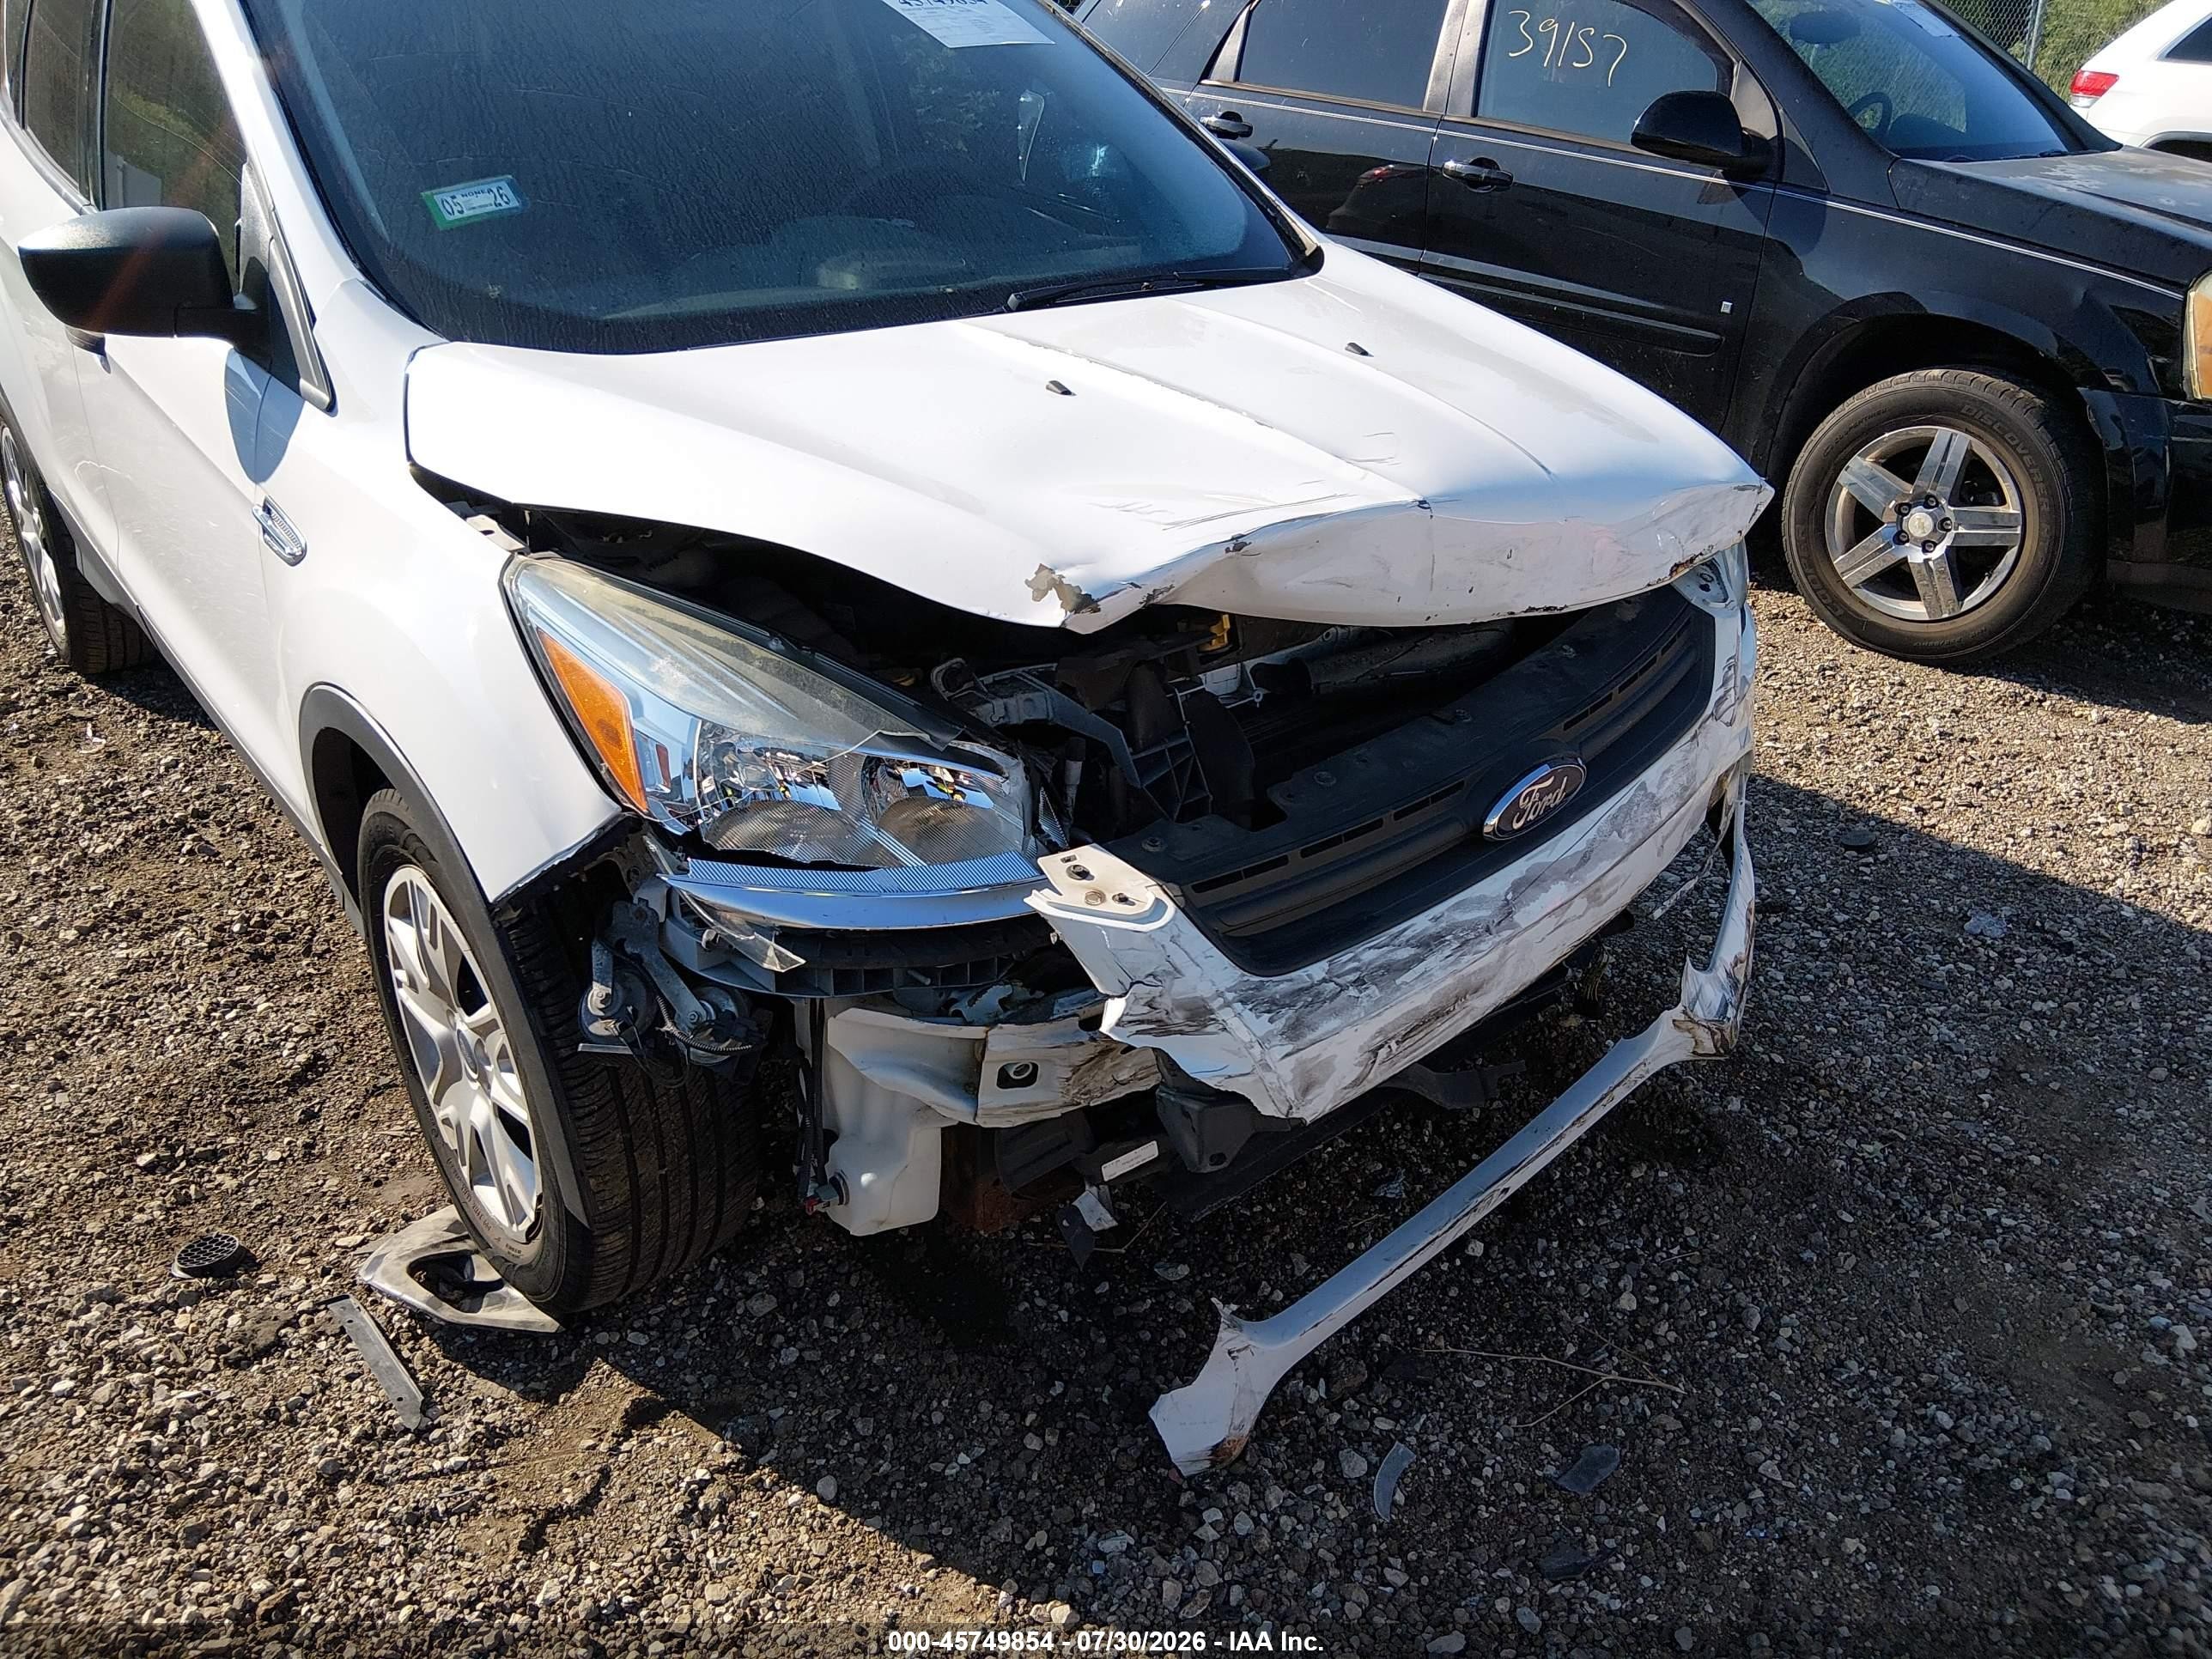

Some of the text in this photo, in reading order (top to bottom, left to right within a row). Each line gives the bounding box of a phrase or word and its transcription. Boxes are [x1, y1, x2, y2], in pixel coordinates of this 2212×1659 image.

[441, 195, 465, 216] 05
[487, 185, 511, 208] 26
[1512, 775, 1568, 830] Ford
